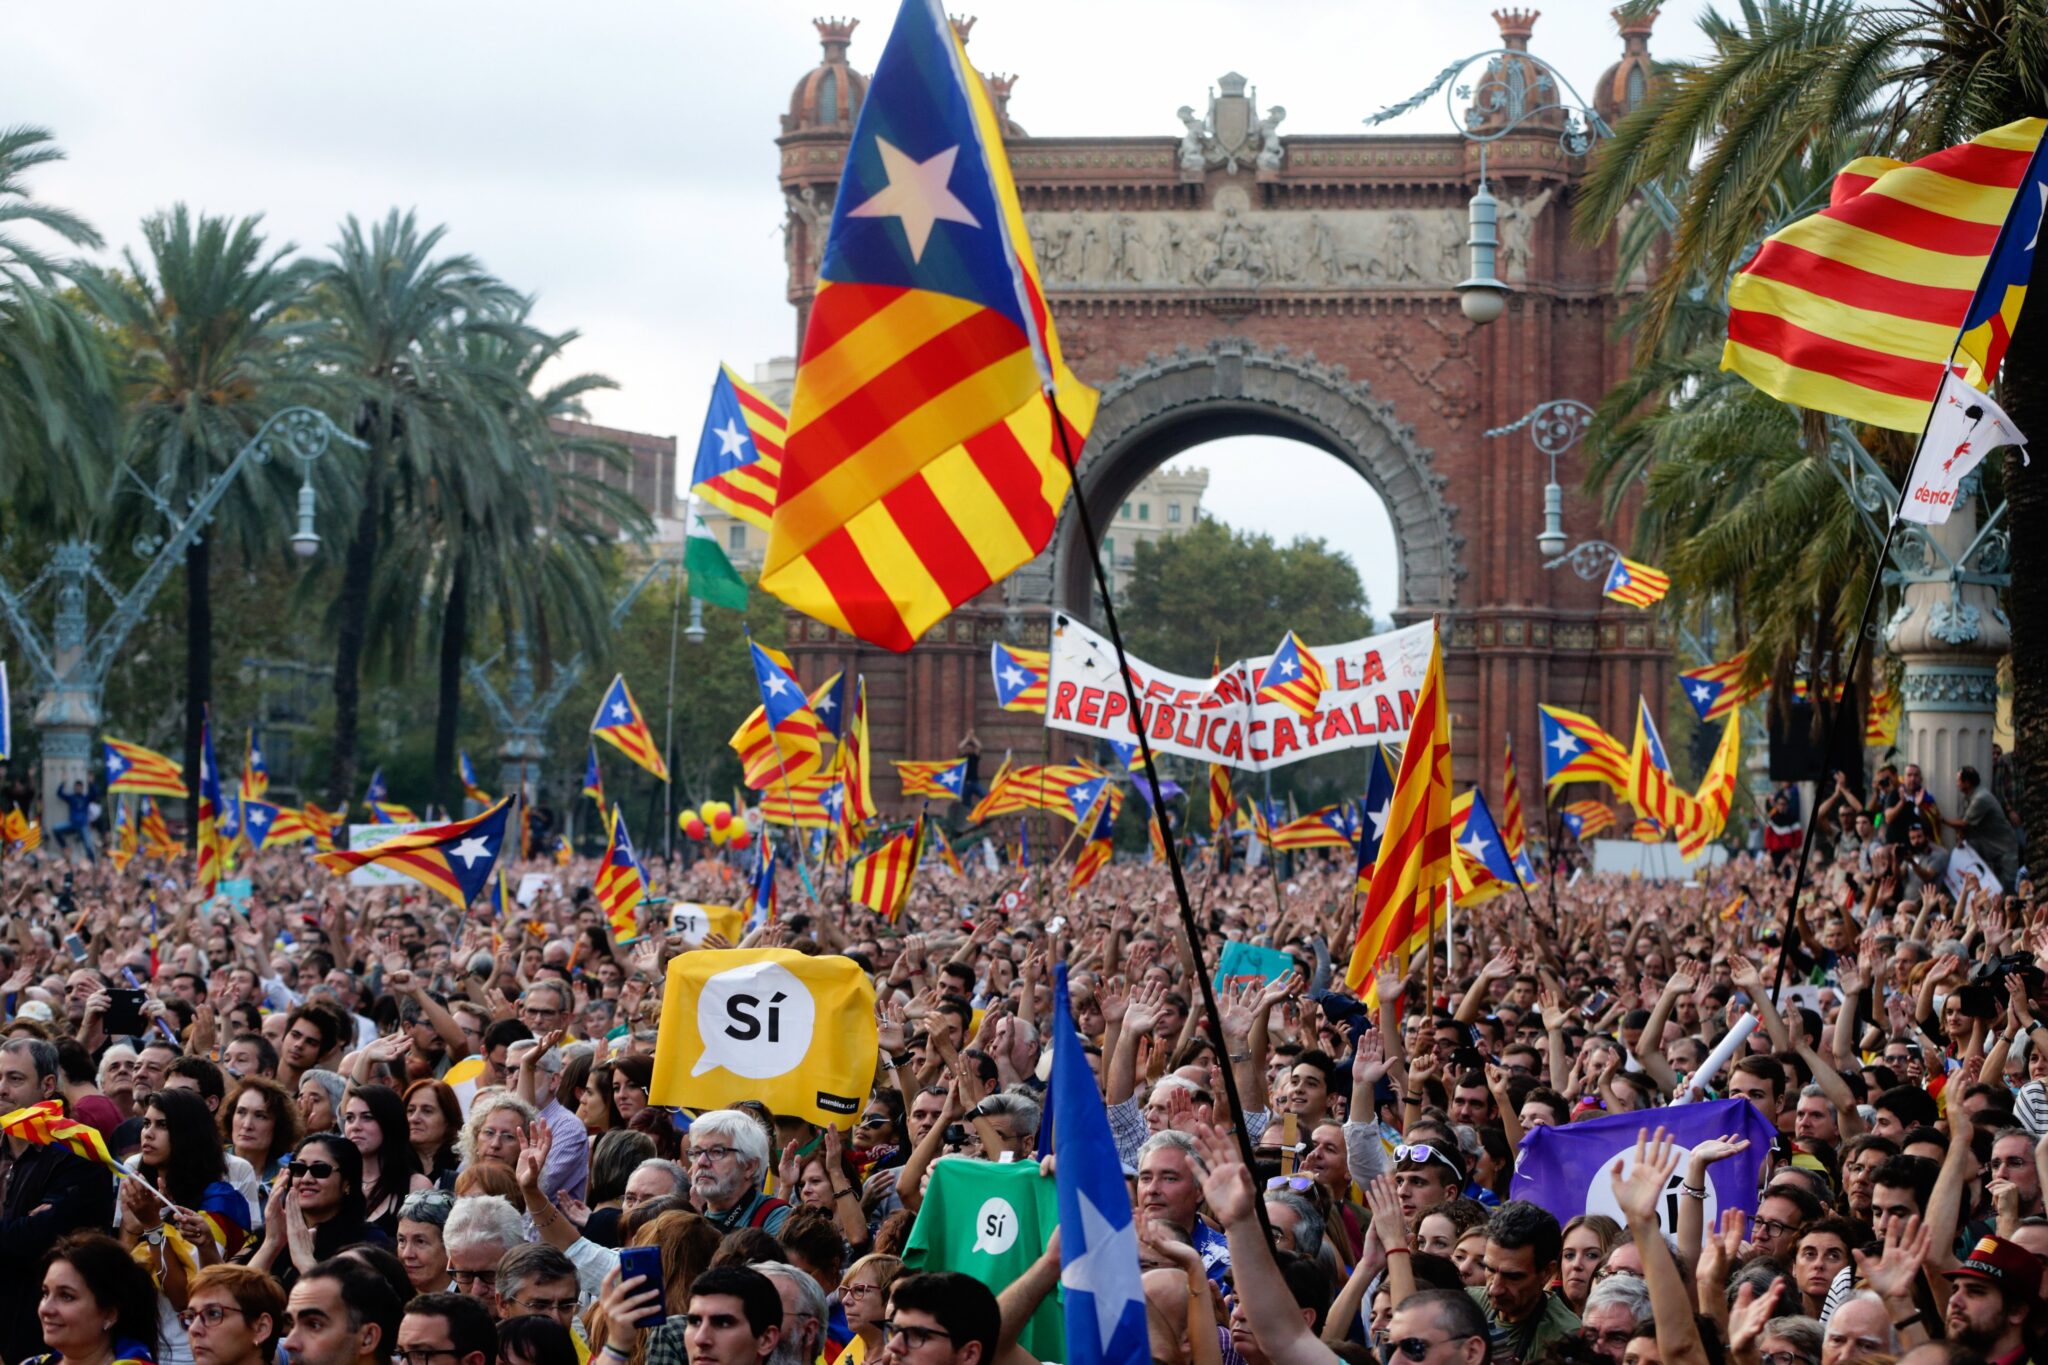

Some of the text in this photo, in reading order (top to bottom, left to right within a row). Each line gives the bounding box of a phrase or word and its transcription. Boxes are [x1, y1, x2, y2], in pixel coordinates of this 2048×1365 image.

[1336, 650, 1387, 691] LA
[1249, 689, 1421, 762] CATALAN
[674, 915, 696, 932] Sí
[724, 991, 788, 1043] Sí
[724, 1204, 741, 1227] SONY
[985, 1214, 1007, 1238] Sí
